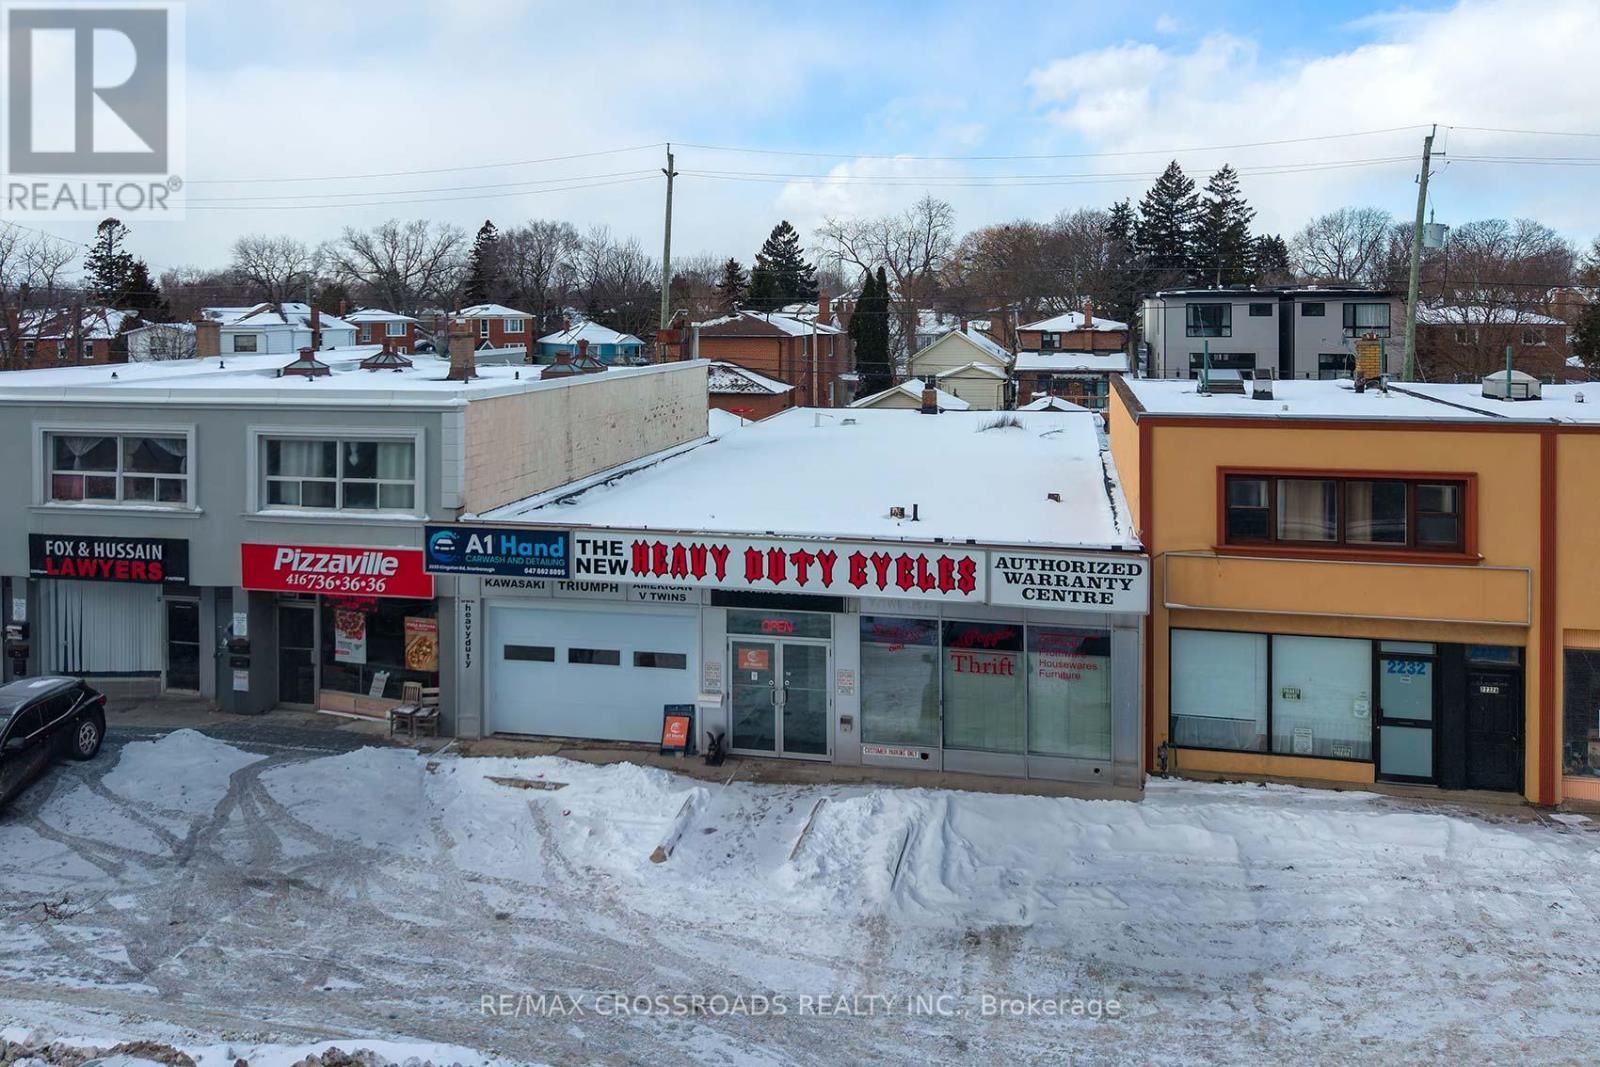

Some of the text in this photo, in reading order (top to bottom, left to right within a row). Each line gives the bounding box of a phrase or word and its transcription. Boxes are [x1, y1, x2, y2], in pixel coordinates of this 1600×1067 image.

[45, 540, 163, 560] FOX & HUSSAIN
[465, 534, 564, 557] A1 Hand
[576, 539, 624, 557] THE
[45, 557, 163, 581] LAWYERS
[273, 548, 399, 576] Pizzaville
[465, 554, 566, 567] CARWASH AND DETAILING
[576, 557, 629, 576] NEW
[631, 539, 977, 596] HEAVY DUTY CYCLES
[994, 556, 1143, 577] AUTHORIZED
[286, 573, 307, 585] 416
[484, 578, 620, 593] KAWASAKI TRIUMPH
[1002, 571, 1134, 591] WARRANTY
[638, 592, 688, 602] V TWINS
[1021, 587, 1114, 605] CENTRE
[761, 619, 794, 633] OPEN
[950, 654, 1016, 676] Thrift
[1039, 659, 1099, 671] Housewares
[1386, 660, 1426, 675] 2232
[1039, 669, 1082, 680] Furniture
